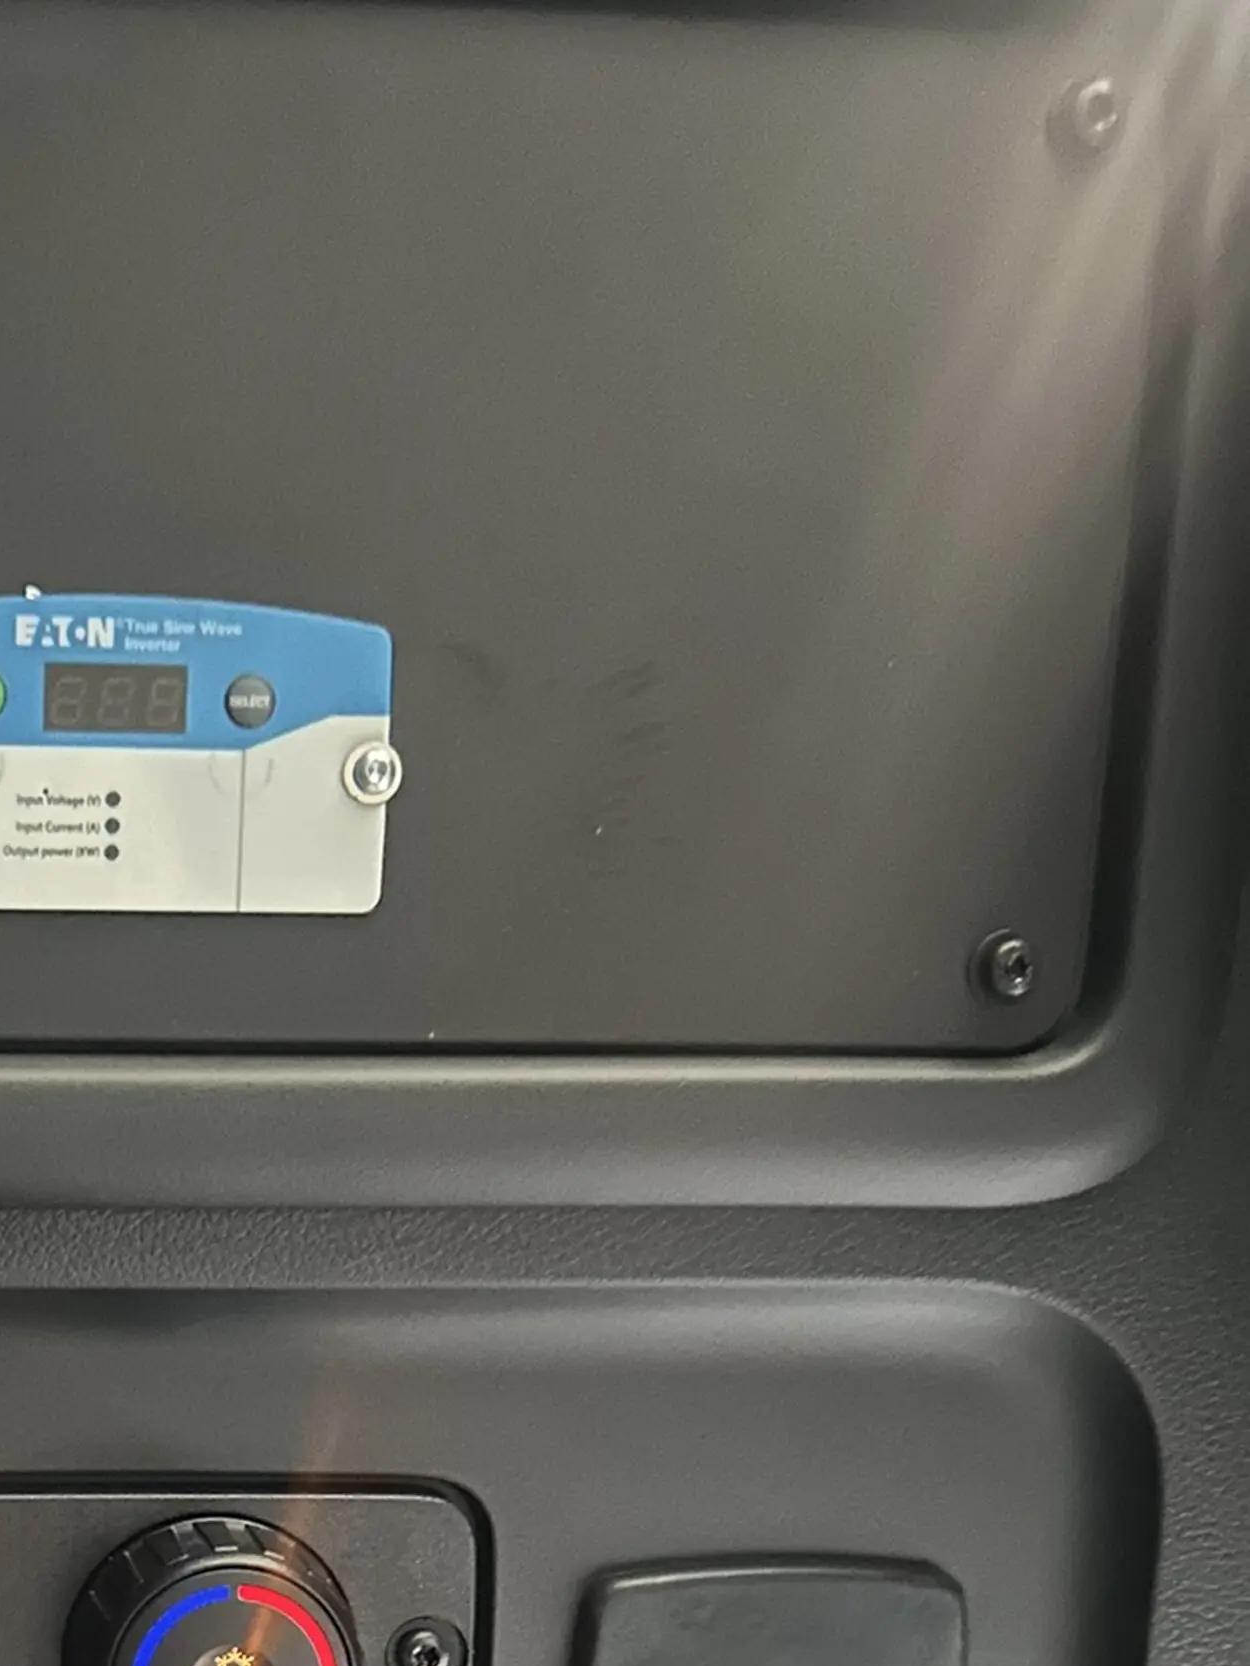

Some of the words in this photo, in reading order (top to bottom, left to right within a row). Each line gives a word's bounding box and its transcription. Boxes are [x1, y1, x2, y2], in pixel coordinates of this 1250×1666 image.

[15, 614, 115, 648] EATON
[125, 618, 158, 634] True
[163, 620, 195, 635] Sine
[200, 621, 243, 636] Wave
[124, 637, 181, 652] Inverter
[16, 821, 43, 834] Input
[45, 821, 82, 832] Current
[86, 821, 100, 834] (A)
[3, 844, 39, 858] Output
[41, 846, 73, 859] power
